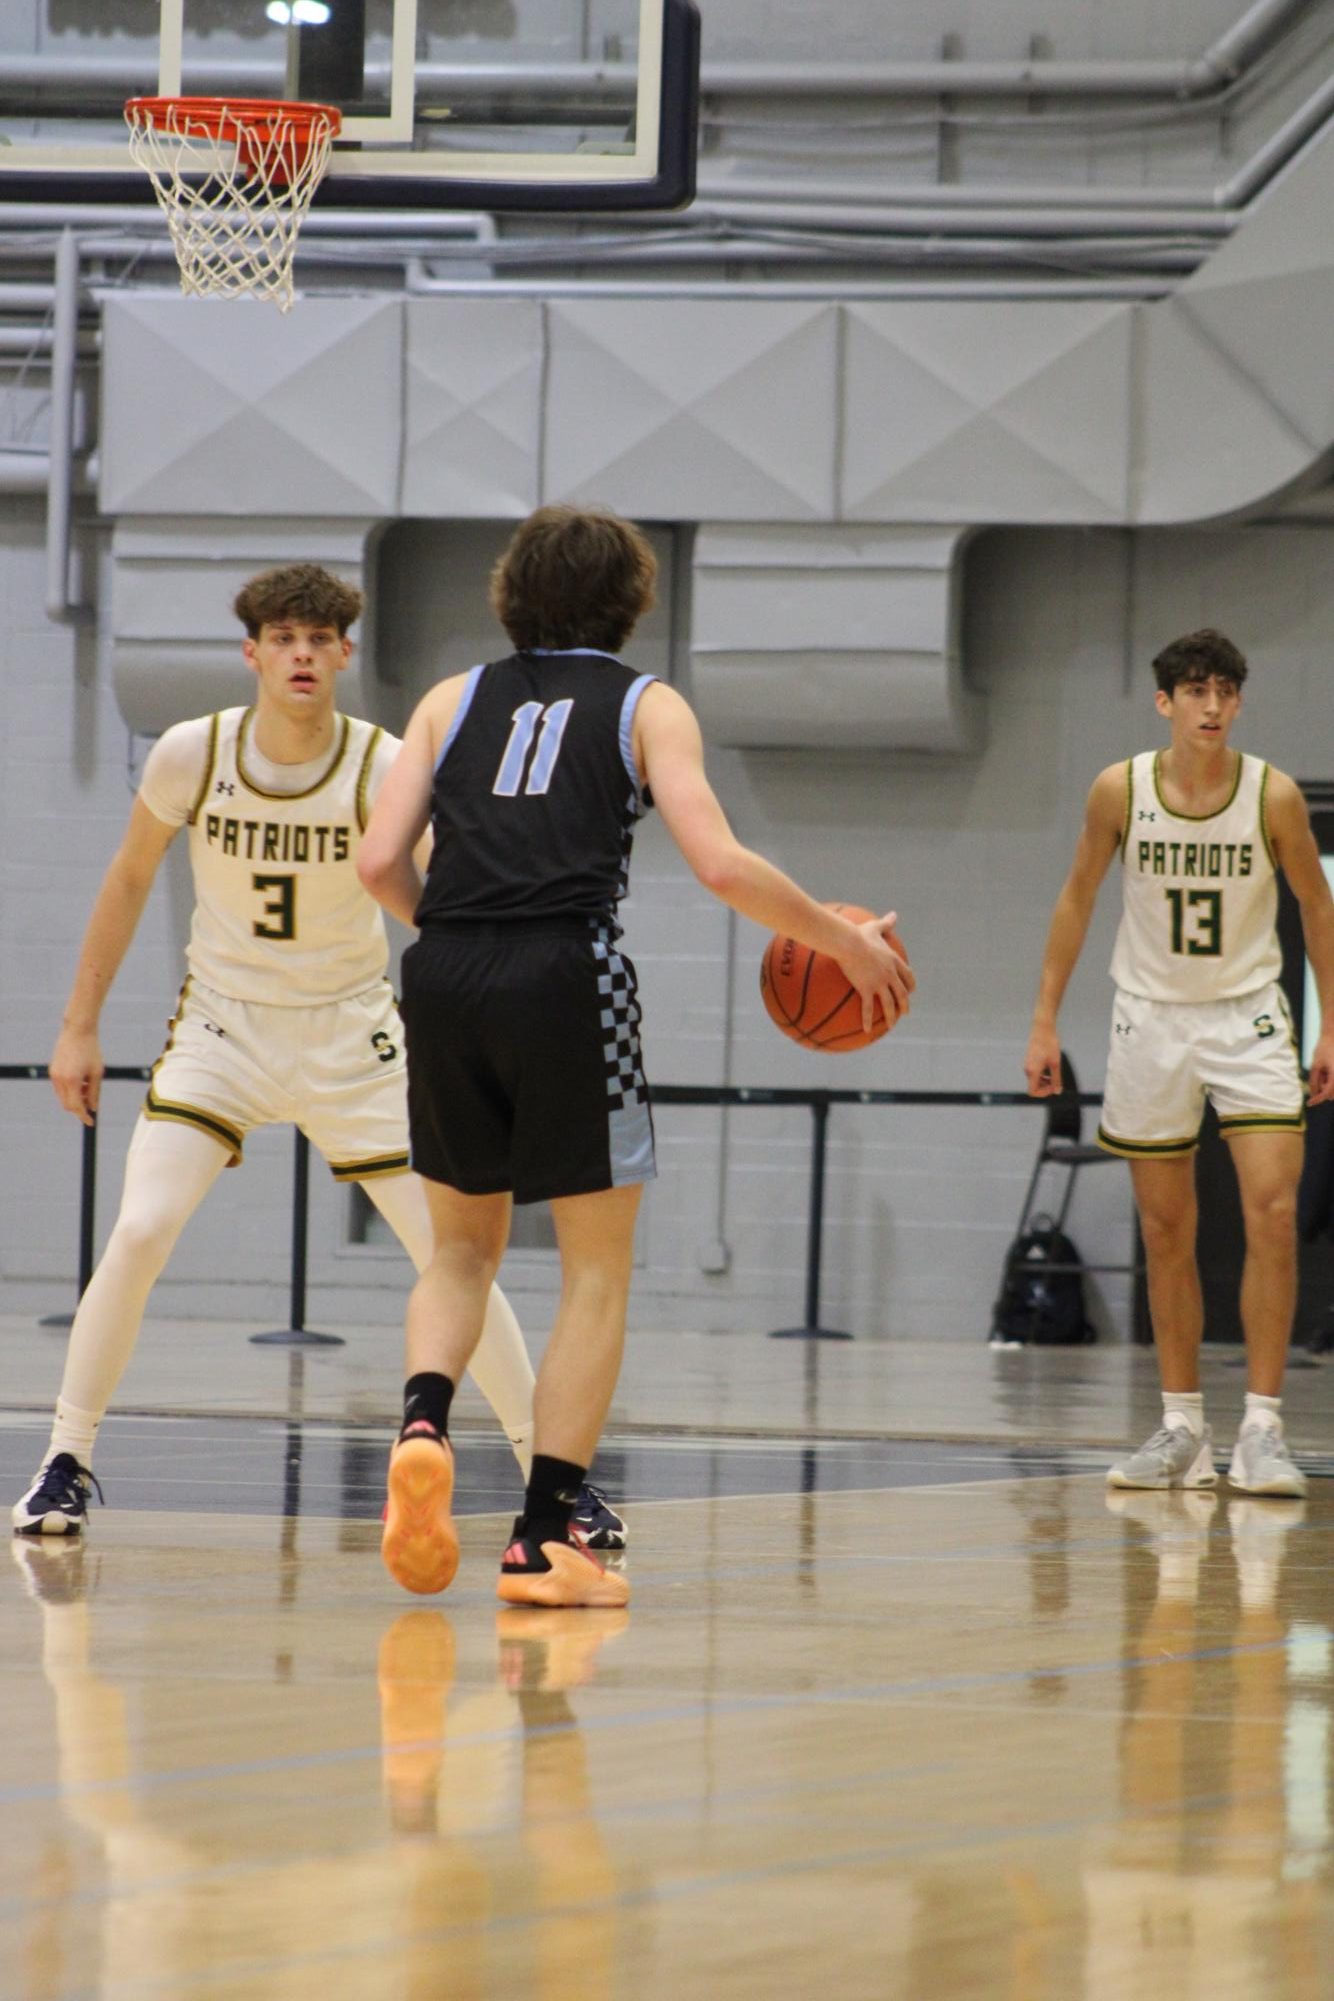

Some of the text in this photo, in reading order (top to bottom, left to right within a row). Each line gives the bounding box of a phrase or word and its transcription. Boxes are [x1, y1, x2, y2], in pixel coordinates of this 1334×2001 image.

[492, 699, 574, 797] 11
[207, 814, 349, 863] PATRIOTS
[1138, 841, 1252, 877] PATRIOTS
[252, 873, 297, 940] 3
[1164, 887, 1223, 957] 13
[371, 1031, 397, 1062] S
